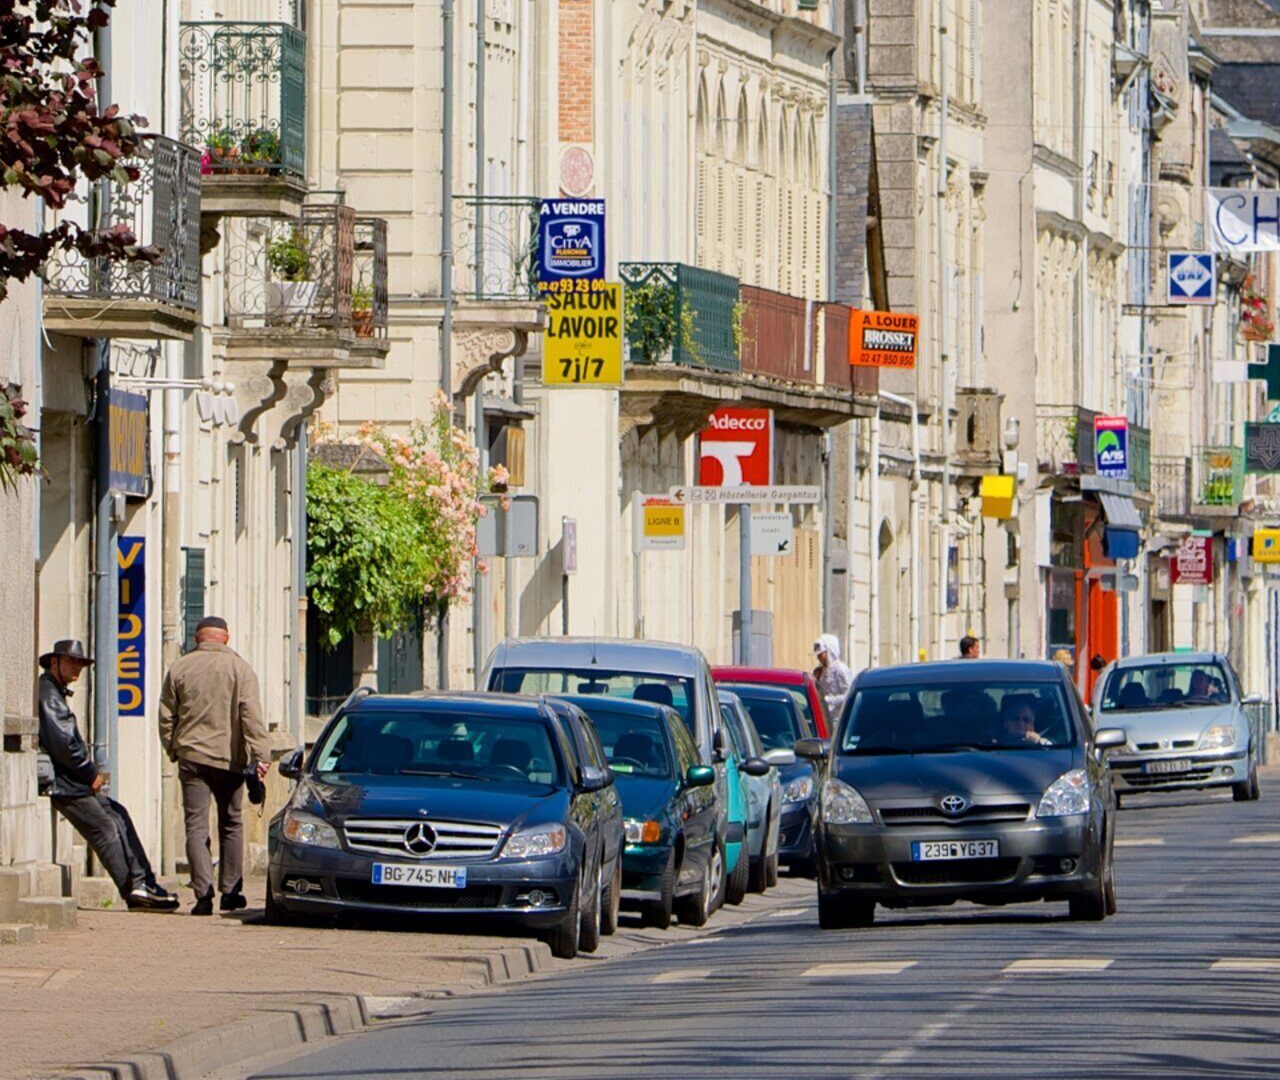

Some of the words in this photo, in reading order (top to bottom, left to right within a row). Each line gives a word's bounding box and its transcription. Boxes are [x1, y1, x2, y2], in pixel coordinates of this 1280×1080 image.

[540, 203, 550, 215] A
[552, 203, 605, 215] VENDRE
[550, 259, 592, 267] IMMOBILIER
[560, 278, 573, 292] 93
[576, 278, 589, 292] 23
[591, 279, 605, 292] 00
[550, 288, 617, 310] SALON
[547, 316, 618, 338] LAVOIR
[863, 314, 871, 325] A
[877, 316, 917, 328] LOUER
[864, 329, 914, 346] BROSSET
[559, 357, 605, 383] 7j/7
[708, 414, 766, 430] Adecco
[771, 490, 818, 501] Gargantua
[648, 517, 671, 525] LIGNE
